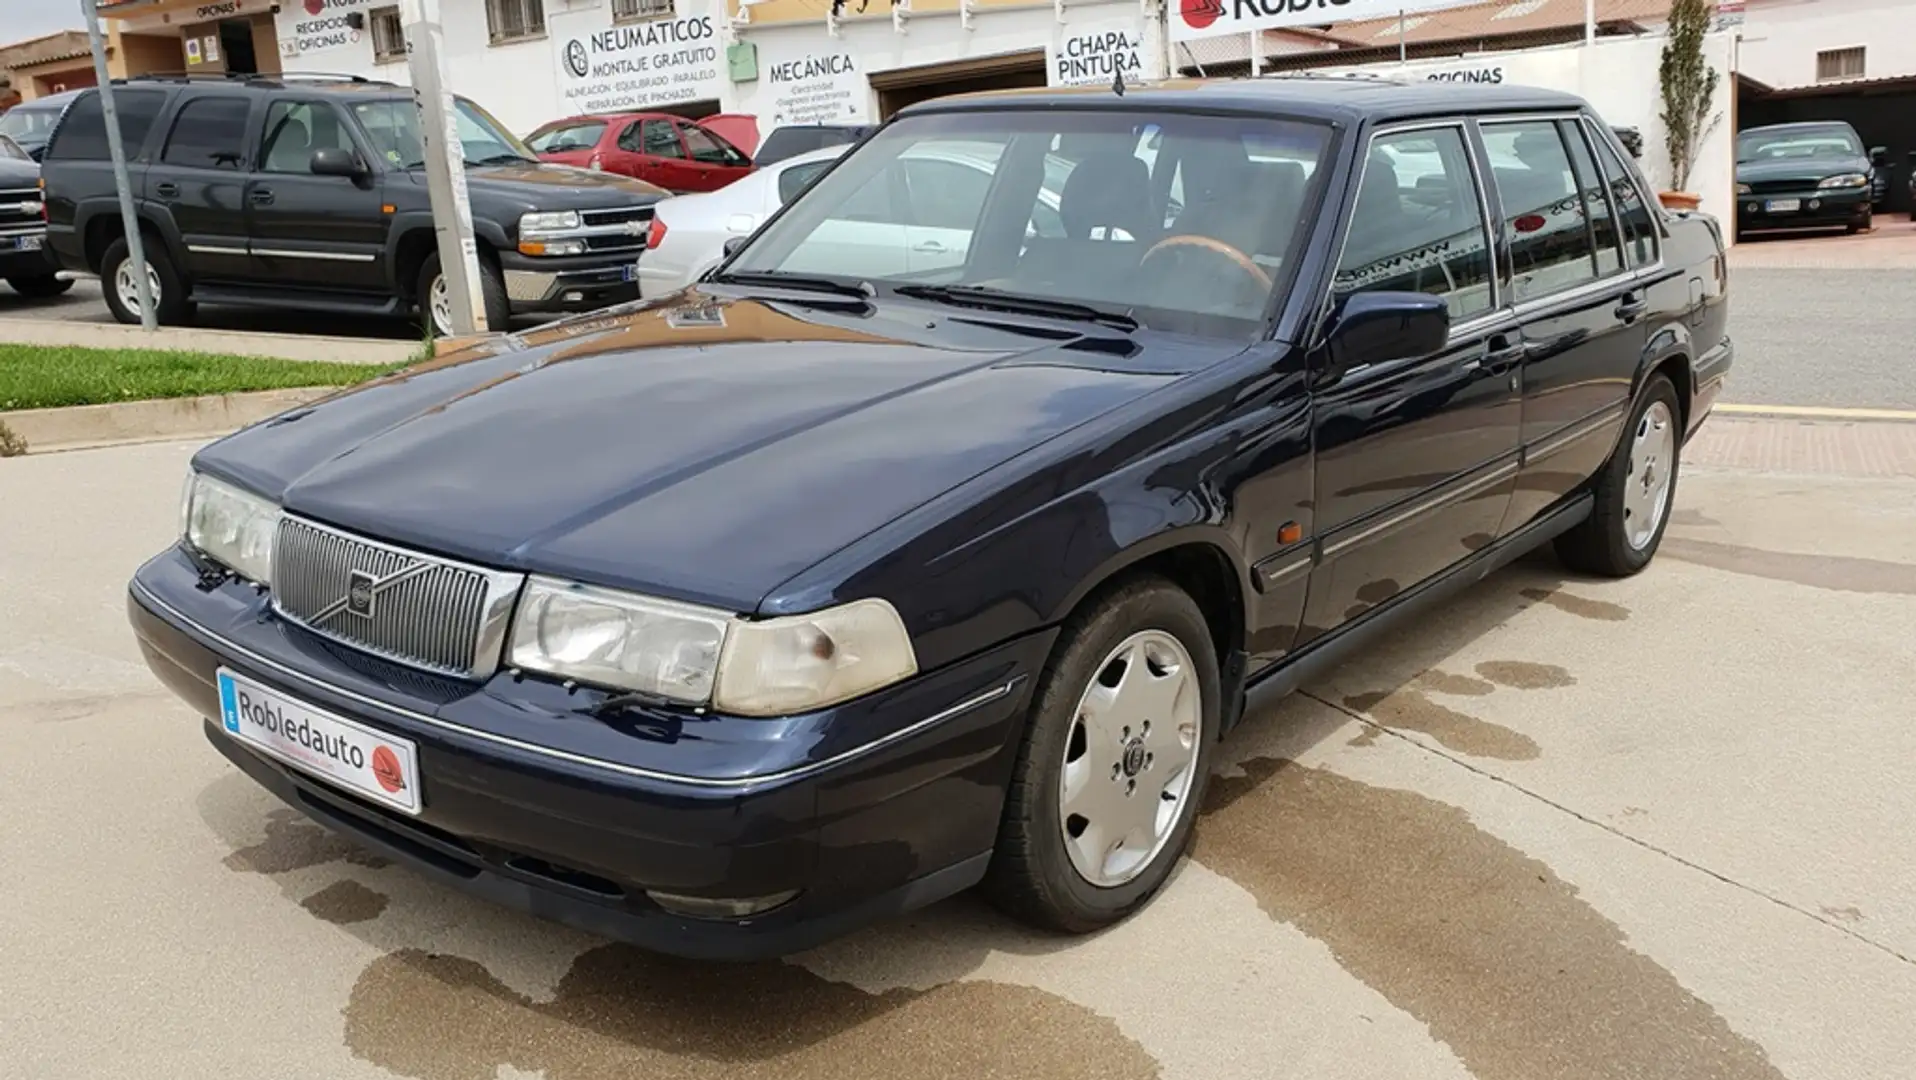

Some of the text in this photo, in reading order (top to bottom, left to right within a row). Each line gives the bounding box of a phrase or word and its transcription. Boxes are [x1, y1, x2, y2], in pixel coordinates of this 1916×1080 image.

[300, 32, 347, 51] OFICINAS
[591, 16, 713, 53] NEUMÁTICOS
[1067, 31, 1129, 57] CHAPA
[592, 46, 716, 77] MONTAJE GRATUITO
[770, 54, 854, 83] MECÁNICA
[1059, 51, 1141, 80] PINTURA
[639, 94, 649, 105] DE
[651, 88, 696, 101] PINCHAZOS
[239, 691, 364, 769] Robledauto
